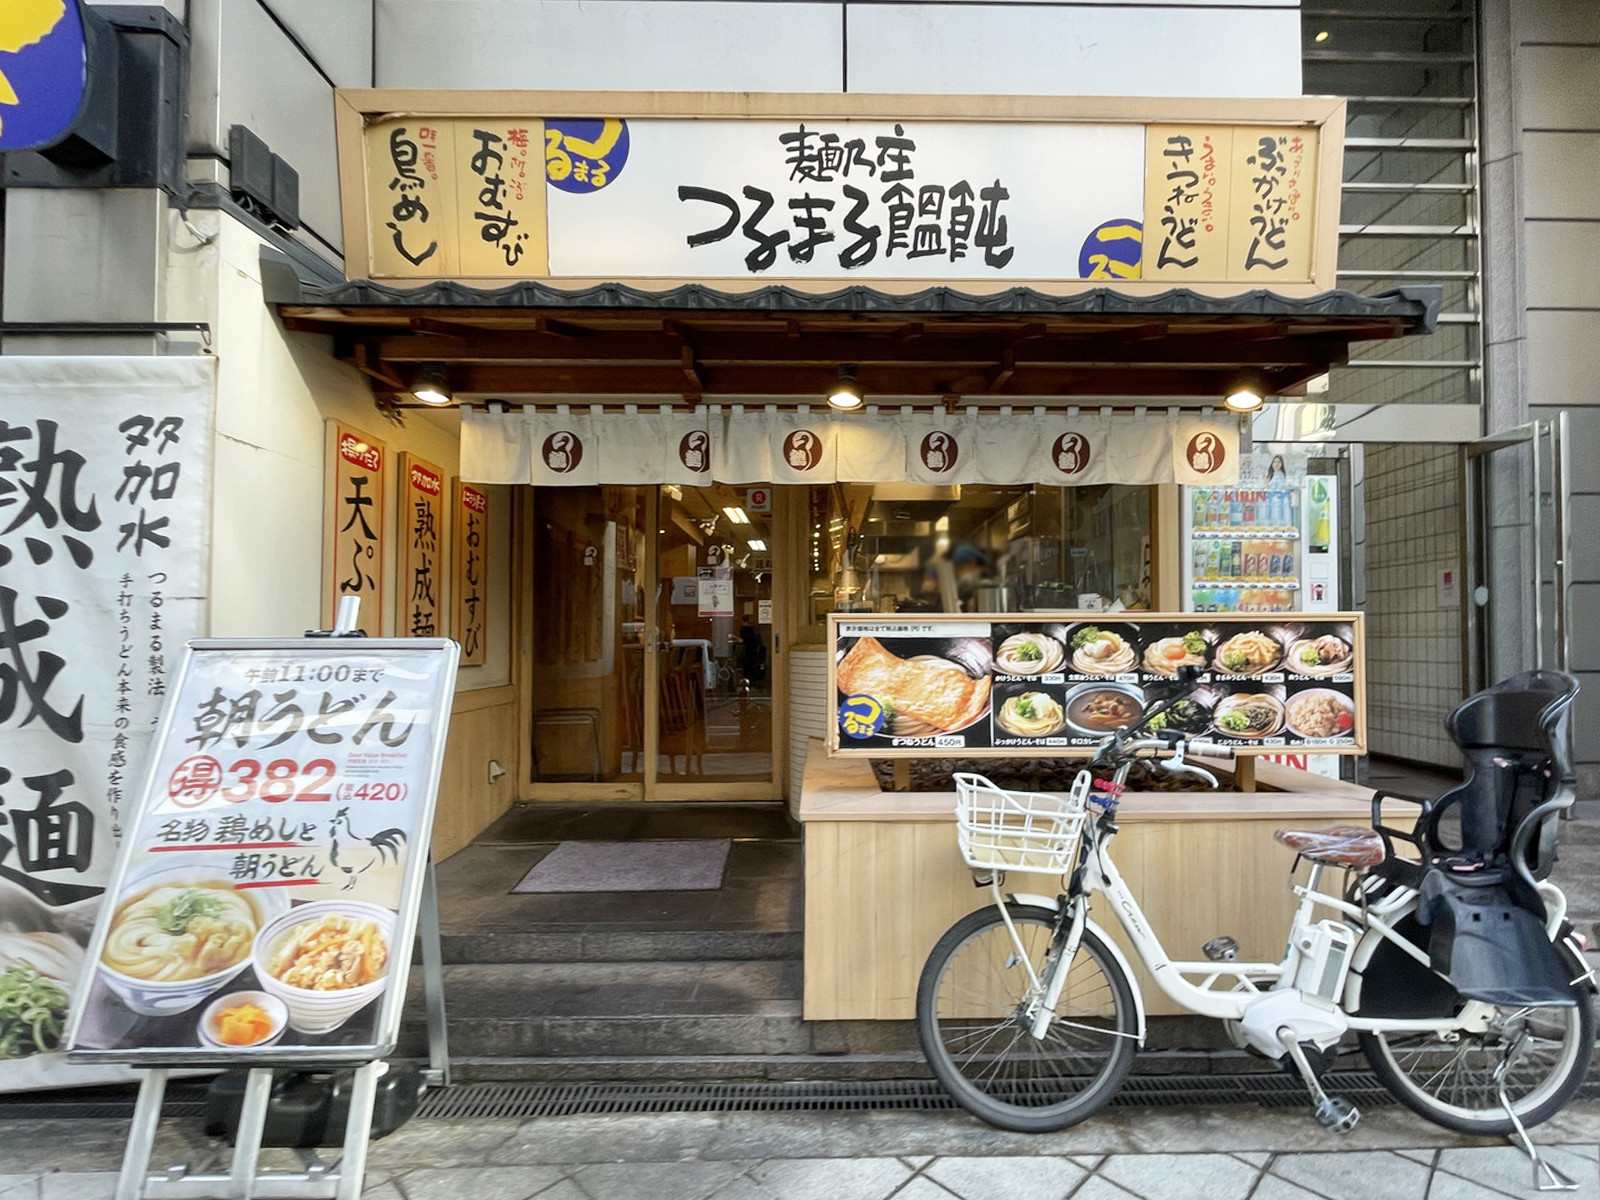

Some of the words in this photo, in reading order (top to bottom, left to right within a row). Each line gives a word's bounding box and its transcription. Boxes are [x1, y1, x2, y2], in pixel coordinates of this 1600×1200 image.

[385, 127, 438, 267] 鳥めし
[471, 128, 530, 267] おむすび
[1157, 135, 1199, 270] きつねうどん
[1245, 136, 1289, 271] ぶっかけうどん
[341, 476, 378, 600] 天ぷ
[1224, 490, 1268, 503] KIRIN
[464, 512, 482, 657] おむすび
[185, 686, 417, 751] 朝うどん
[244, 664, 385, 684] 午前11:00まで
[221, 758, 337, 804] 382
[229, 852, 327, 879] 朝うどん
